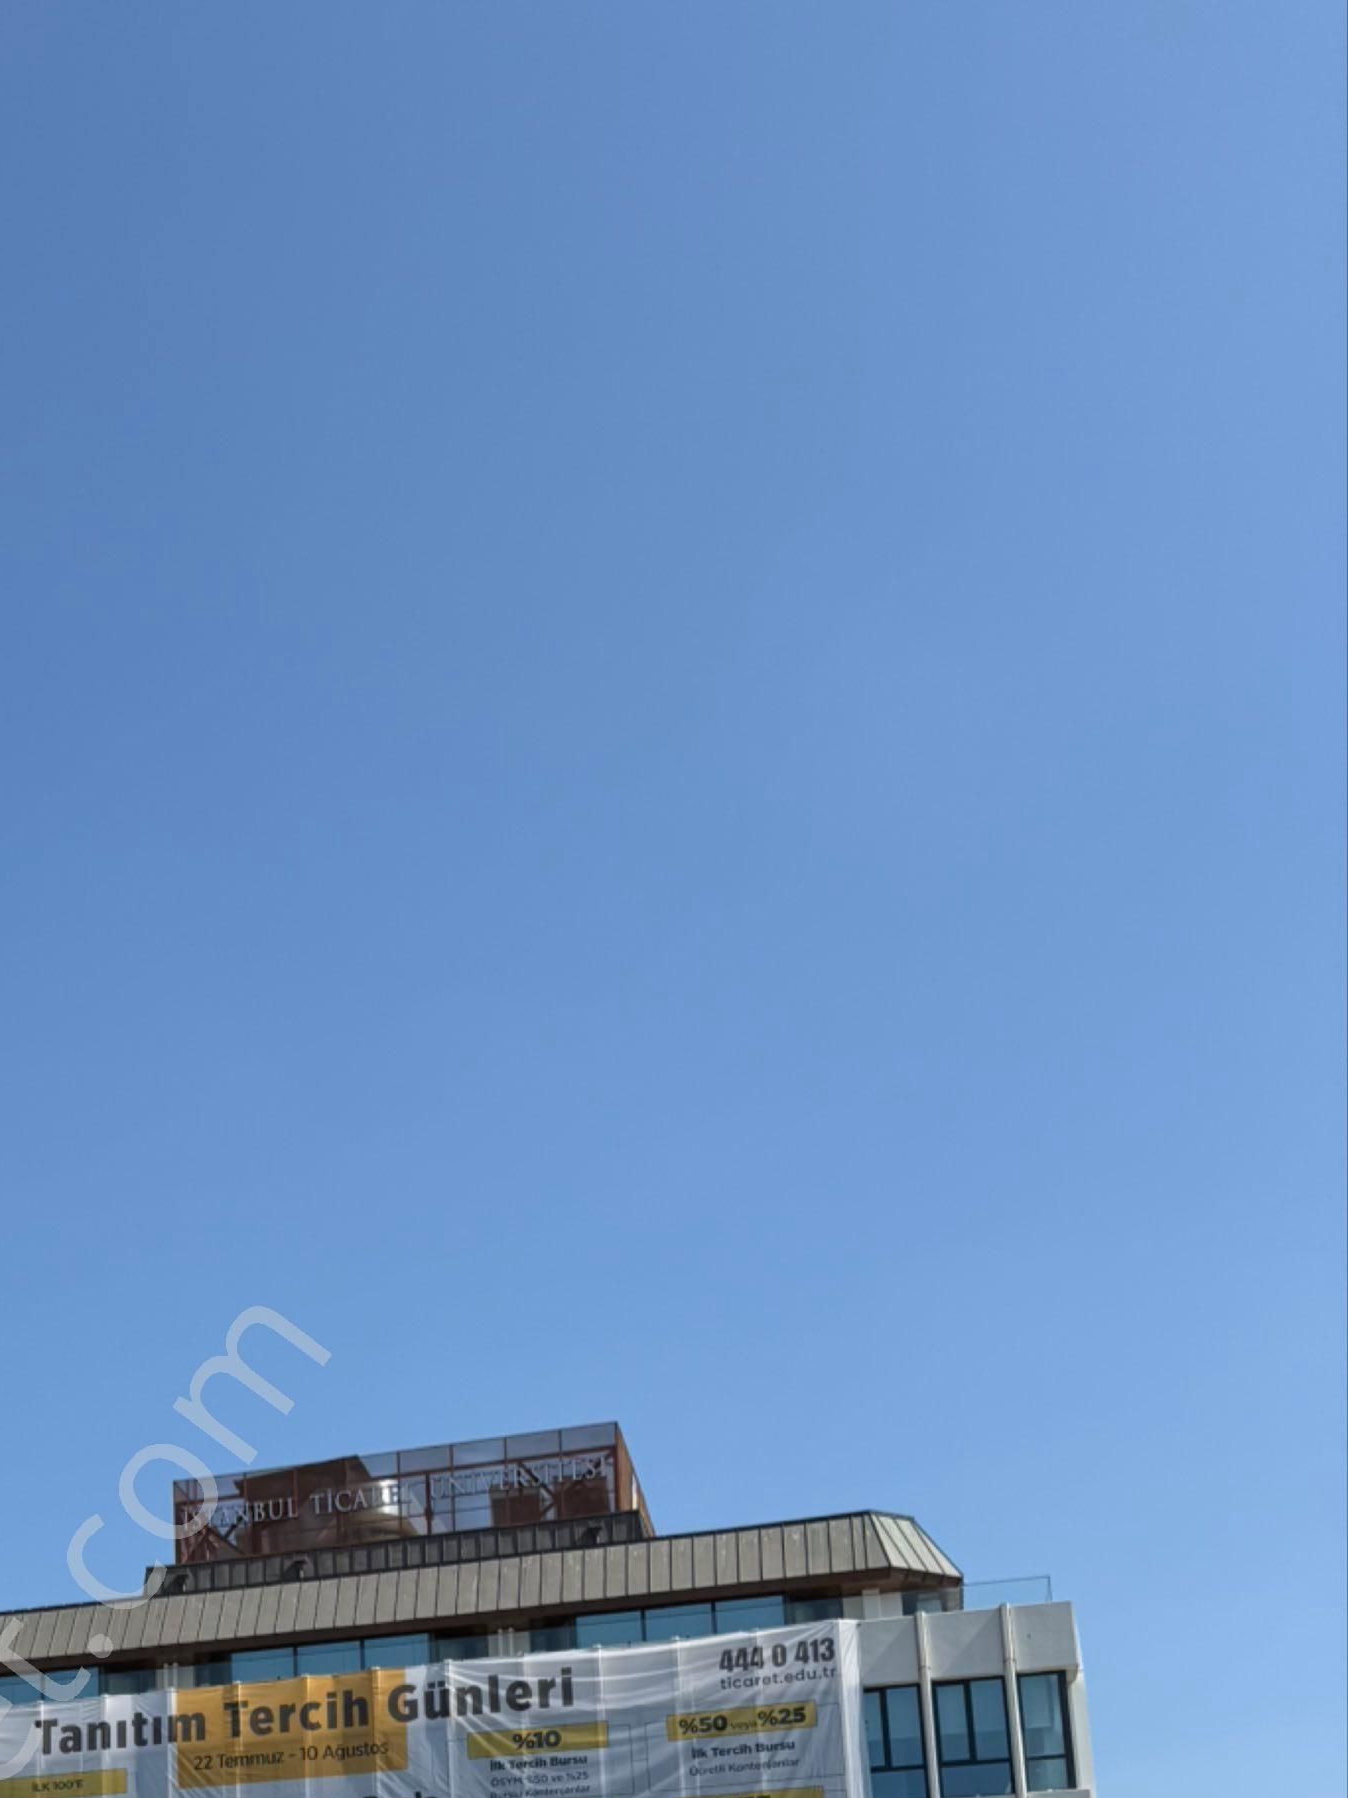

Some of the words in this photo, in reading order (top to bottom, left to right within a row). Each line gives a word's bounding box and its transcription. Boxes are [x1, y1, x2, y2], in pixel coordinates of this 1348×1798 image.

[719, 1644, 764, 1673] 444
[771, 1643, 787, 1668] 0
[795, 1637, 835, 1664] 413
[720, 1667, 837, 1690] ticaret.edu.tr
[35, 1710, 206, 1756] Tanıtım
[223, 1689, 369, 1739] Tercih
[388, 1667, 575, 1723] Günleri
[679, 1714, 728, 1735] %50
[757, 1706, 806, 1726] %25
[513, 1730, 561, 1750] %10
[712, 1743, 753, 1758] Tercih
[756, 1740, 796, 1753] Bursu
[194, 1755, 212, 1771] 22
[218, 1750, 285, 1768] Temmuz
[300, 1746, 318, 1762] 10
[323, 1741, 389, 1761] Ağustos
[509, 1756, 547, 1770] Tercih
[550, 1755, 588, 1768] Bursu
[31, 1779, 50, 1793] İLK
